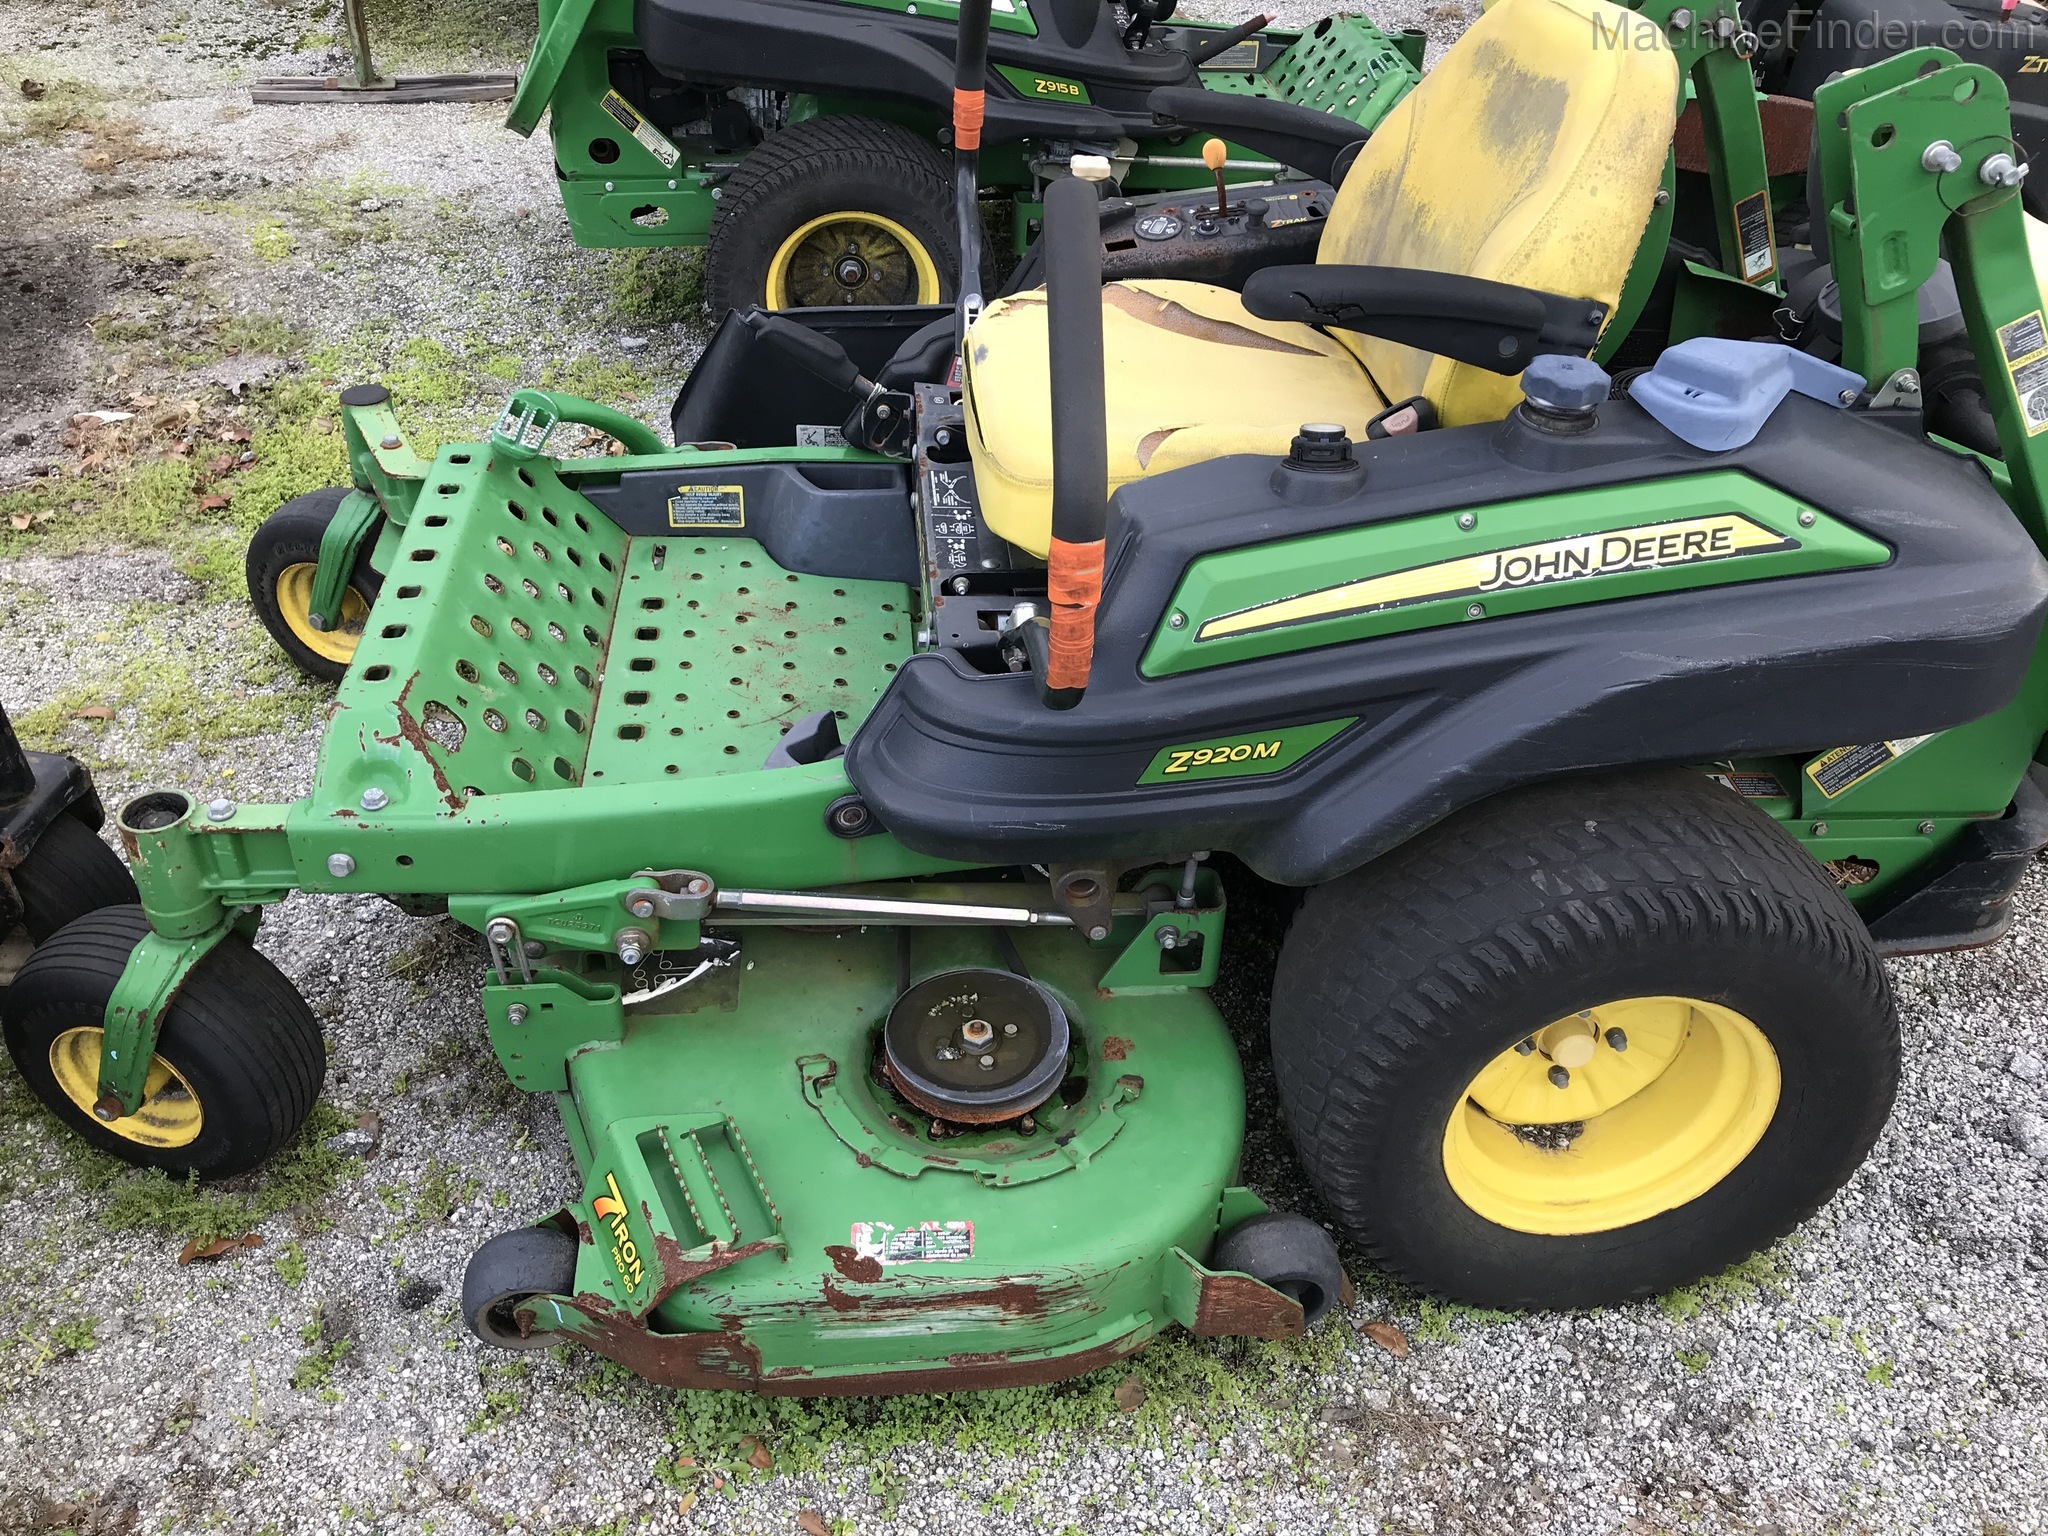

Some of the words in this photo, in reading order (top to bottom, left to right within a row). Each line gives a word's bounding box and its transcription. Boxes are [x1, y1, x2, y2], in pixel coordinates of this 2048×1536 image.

[1479, 546, 1590, 588] JOHN
[1601, 526, 1734, 568] DEERE
[1163, 740, 1283, 775] Z920M
[611, 1245, 625, 1274] PRO
[623, 1274, 634, 1294] 60
